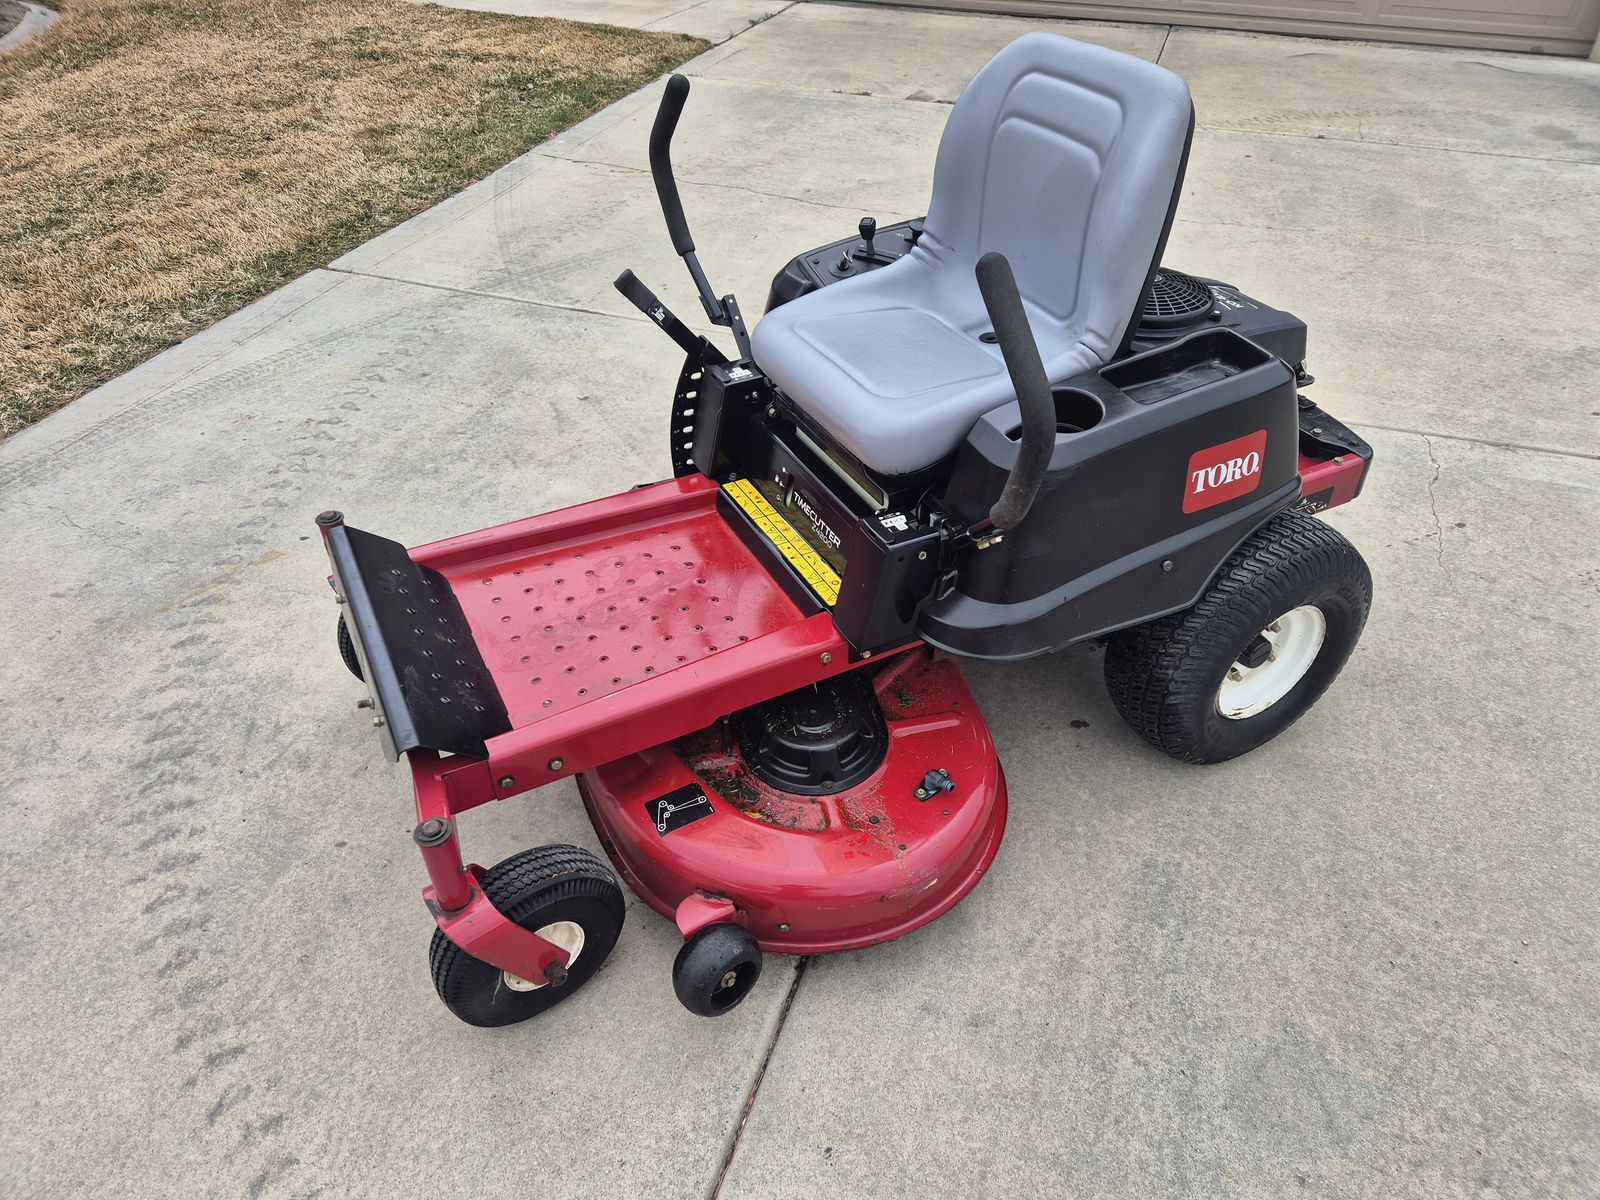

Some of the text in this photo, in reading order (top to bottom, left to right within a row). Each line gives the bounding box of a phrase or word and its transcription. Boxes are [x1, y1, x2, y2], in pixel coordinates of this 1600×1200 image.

[1191, 451, 1260, 494] TORO
[793, 491, 841, 549] TIMECUTTER
[811, 522, 833, 549] Z4200
